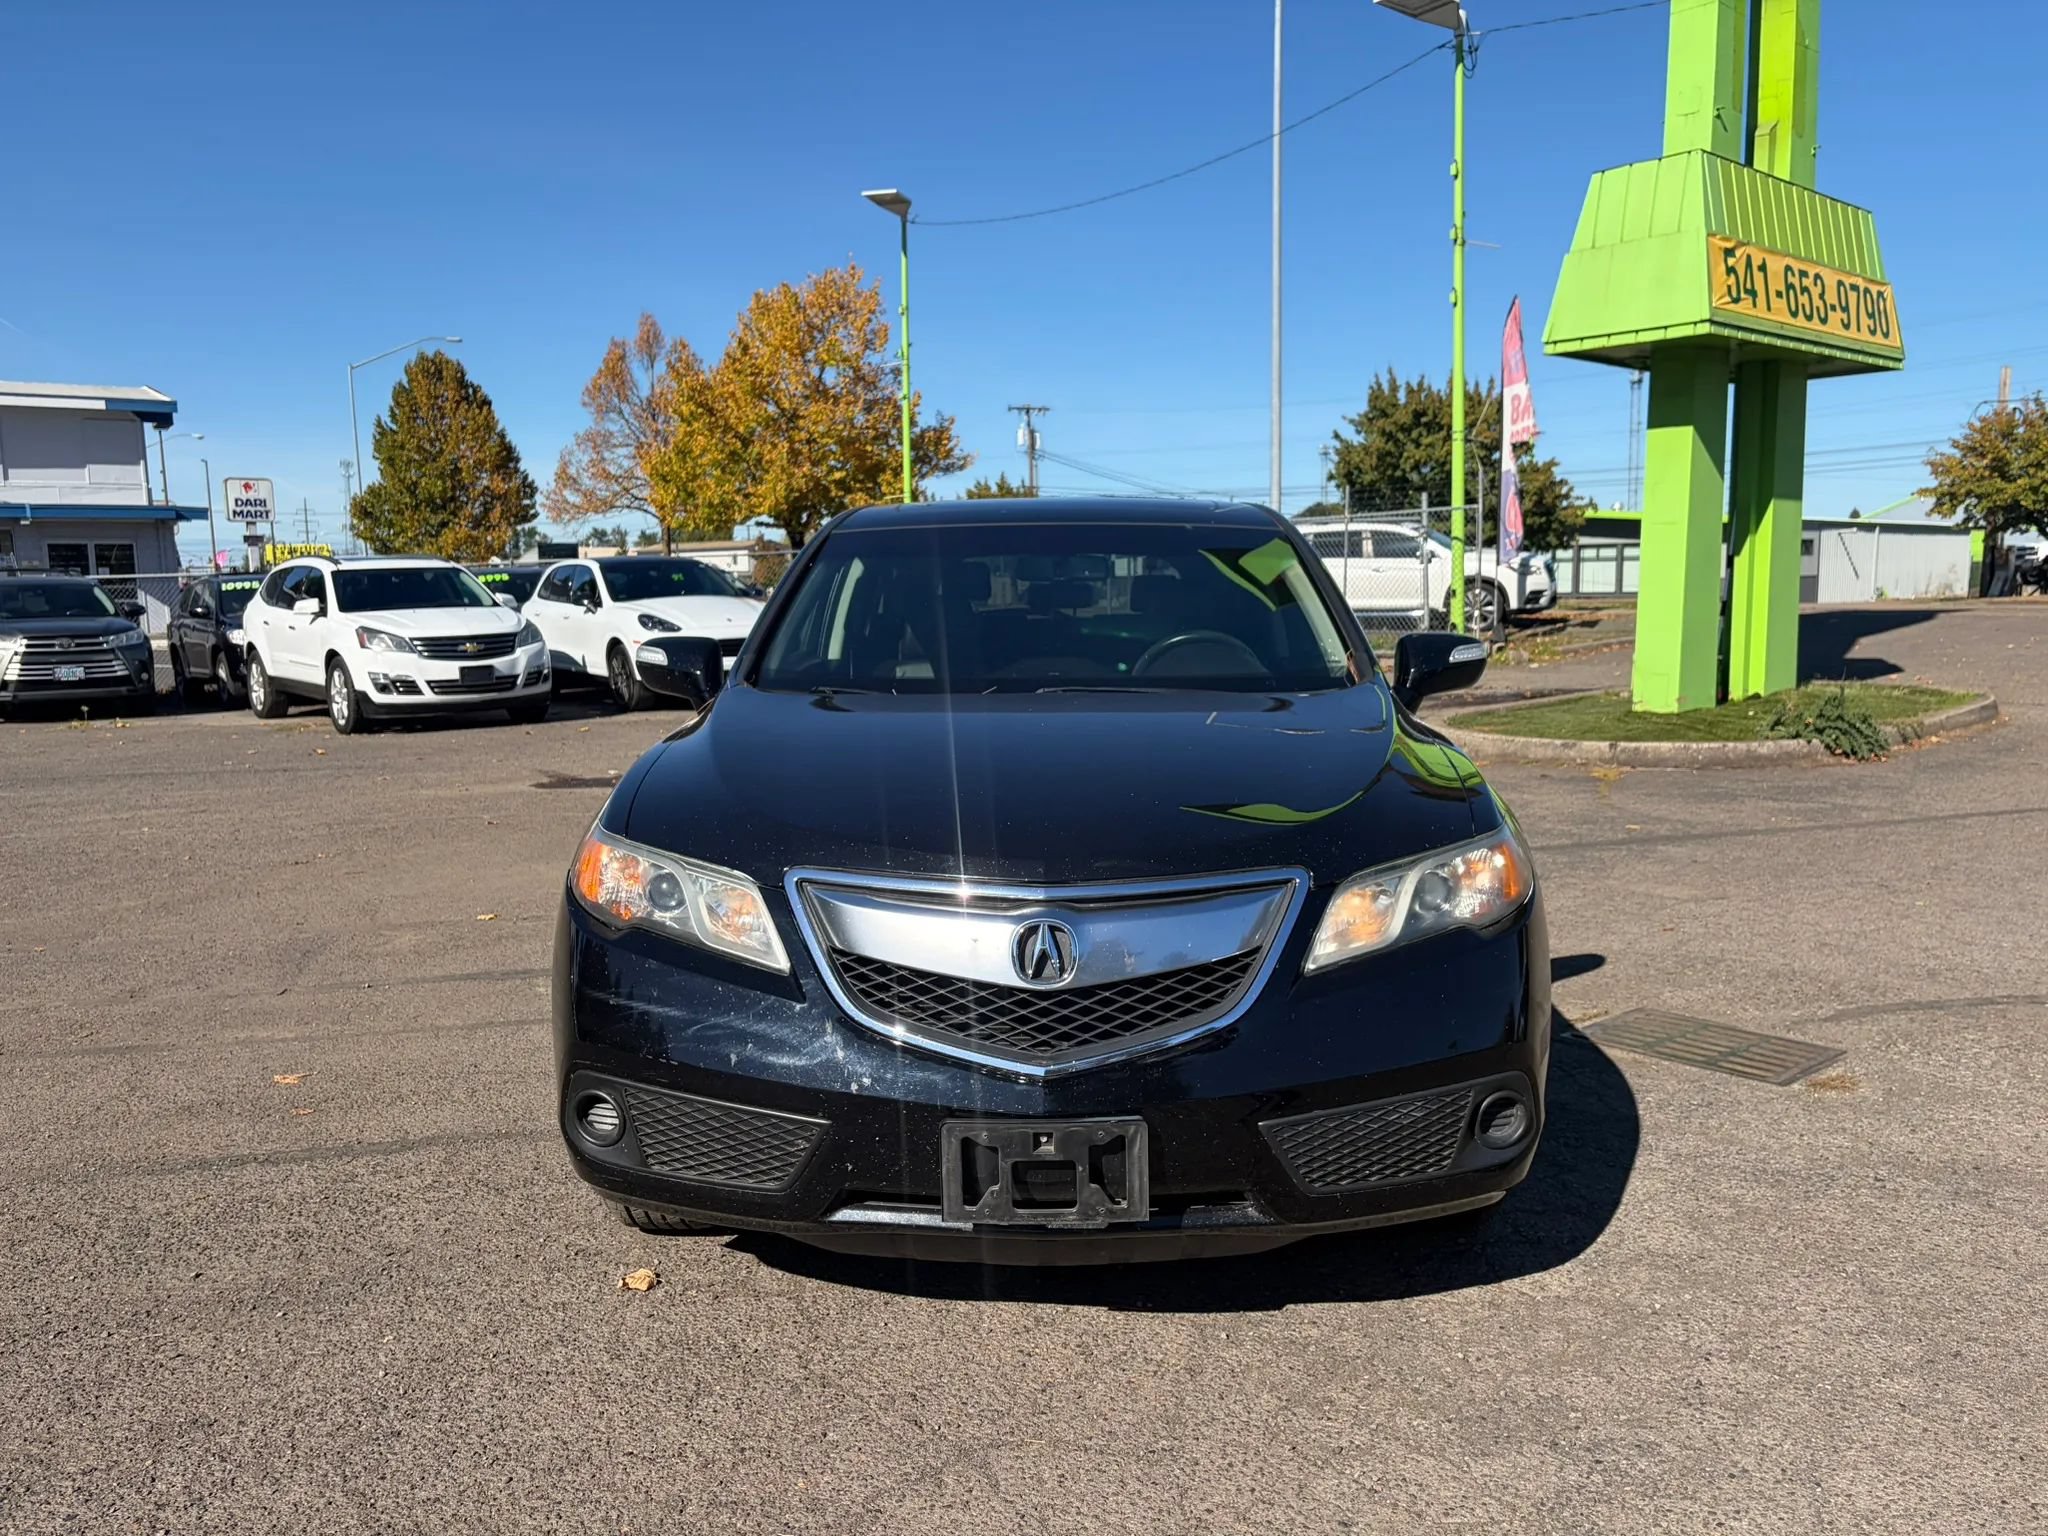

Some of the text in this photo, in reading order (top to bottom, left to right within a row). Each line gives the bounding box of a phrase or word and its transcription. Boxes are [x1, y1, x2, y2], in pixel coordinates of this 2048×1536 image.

[1723, 247, 1890, 340] 541-653-9790
[234, 497, 267, 508] DARI
[232, 509, 271, 520] MART
